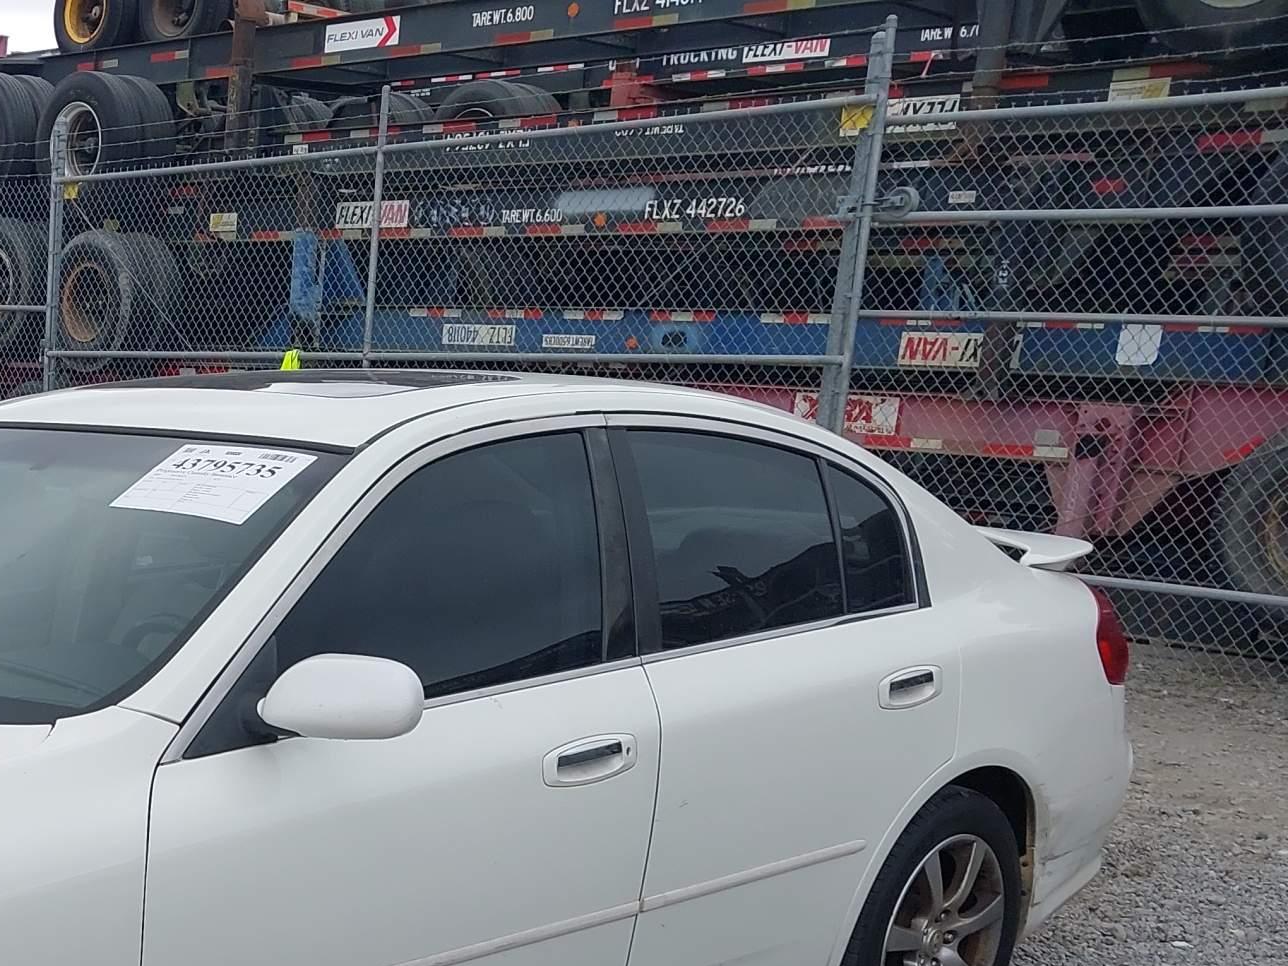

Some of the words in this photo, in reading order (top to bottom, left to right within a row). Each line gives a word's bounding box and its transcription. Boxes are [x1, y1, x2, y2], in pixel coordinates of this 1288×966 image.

[326, 30, 359, 44] FLEXI
[360, 27, 385, 39] VAN
[644, 200, 682, 219] FLXZ
[686, 197, 745, 218] 442726
[172, 458, 283, 479] 43795735
